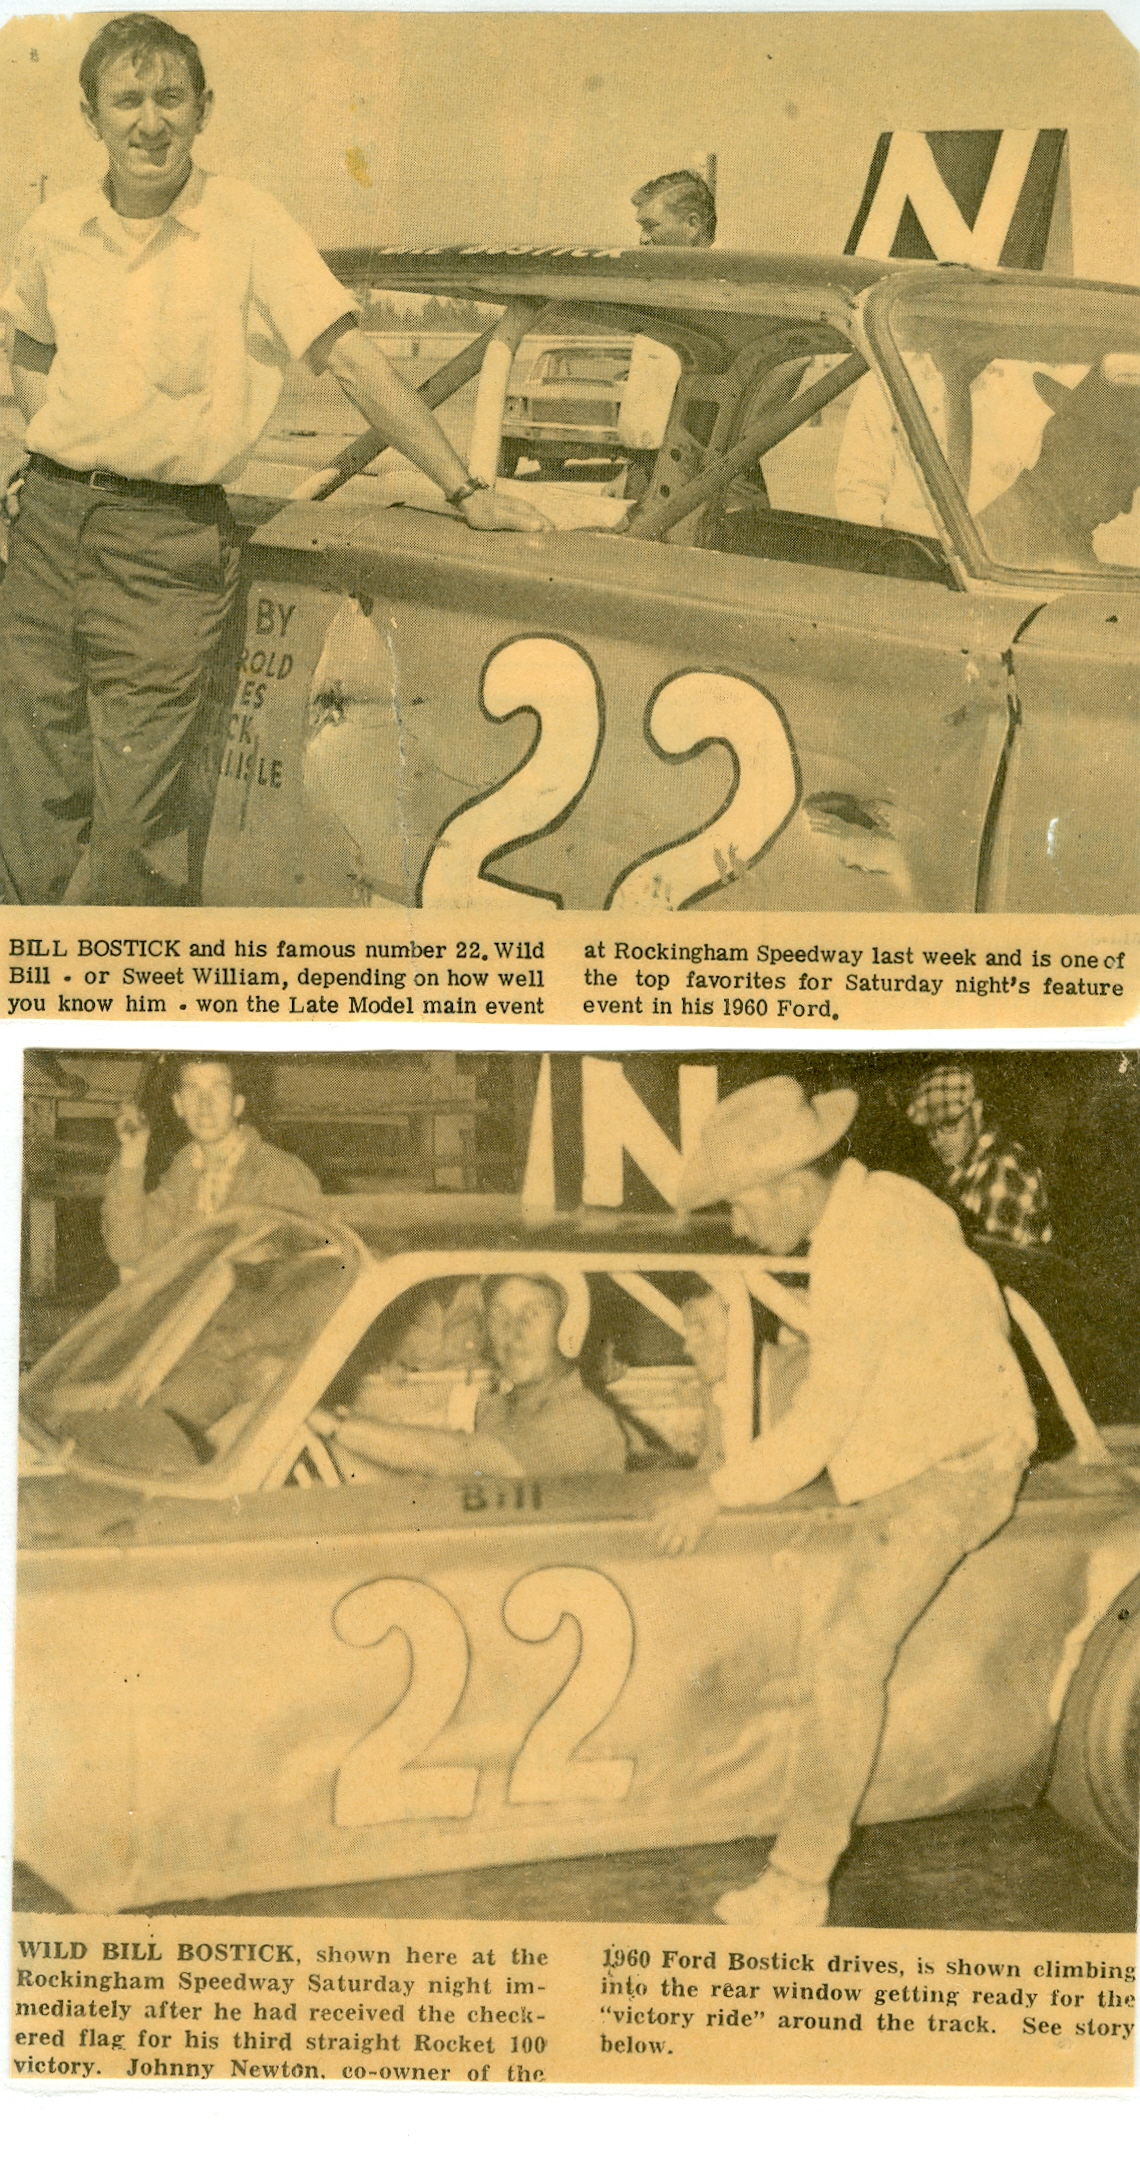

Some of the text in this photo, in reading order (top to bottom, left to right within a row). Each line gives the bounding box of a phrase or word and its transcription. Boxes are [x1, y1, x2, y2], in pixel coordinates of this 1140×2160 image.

[853, 129, 1041, 270] N
[256, 598, 296, 637] BY
[415, 631, 803, 911] 22
[8, 938, 546, 962] BILL BOSTICK and his famous number 22. Wild
[584, 940, 1126, 970] at Rockingham Speedway last week and is one of
[8, 966, 51, 985] Bill
[84, 970, 111, 985] or
[122, 966, 185, 986] Sweet
[191, 967, 289, 991] William,
[297, 967, 407, 990] depending
[413, 972, 440, 987] on
[446, 968, 490, 988] how
[497, 969, 545, 988] well
[583, 967, 1124, 998] the top favorites for Saturday night's feature
[7, 997, 46, 1016] you
[57, 993, 114, 1013] know
[125, 994, 167, 1013] him
[195, 998, 239, 1014] won
[246, 994, 281, 1014] the
[288, 995, 340, 1014] Late
[348, 995, 415, 1015] Model
[422, 996, 477, 1015] main
[485, 996, 545, 1015] event
[582, 995, 840, 1022] event in his 1960 Ford.
[581, 1055, 718, 1210] N
[462, 1482, 542, 1511] Bill
[330, 1563, 638, 1829] 22
[17, 1939, 549, 1967] WILD BILL BOSTICK, shown here at the
[602, 1948, 1137, 1983] 1960 Ford Bostick drives, is shown climbing
[16, 1967, 546, 1997] Rockingham Speedway Saturday night im-
[601, 1975, 1136, 2009] into the rear window getting ready for the
[15, 1999, 546, 2024] mediately after he had received the check-
[14, 2028, 548, 2055] ered flag for his third straight Rocket 100
[777, 2013, 863, 2032] around
[876, 2013, 915, 2033] the
[927, 2013, 996, 2034] track.
[1022, 2016, 1062, 2036] See
[1075, 2018, 1135, 2041] story
[599, 2032, 674, 2055] below.
[12, 2055, 102, 2079] victory.
[126, 2057, 215, 2080] Johnny
[341, 2065, 451, 2081] co-owner
[467, 2064, 491, 2082] of
[507, 2064, 546, 2083] the
